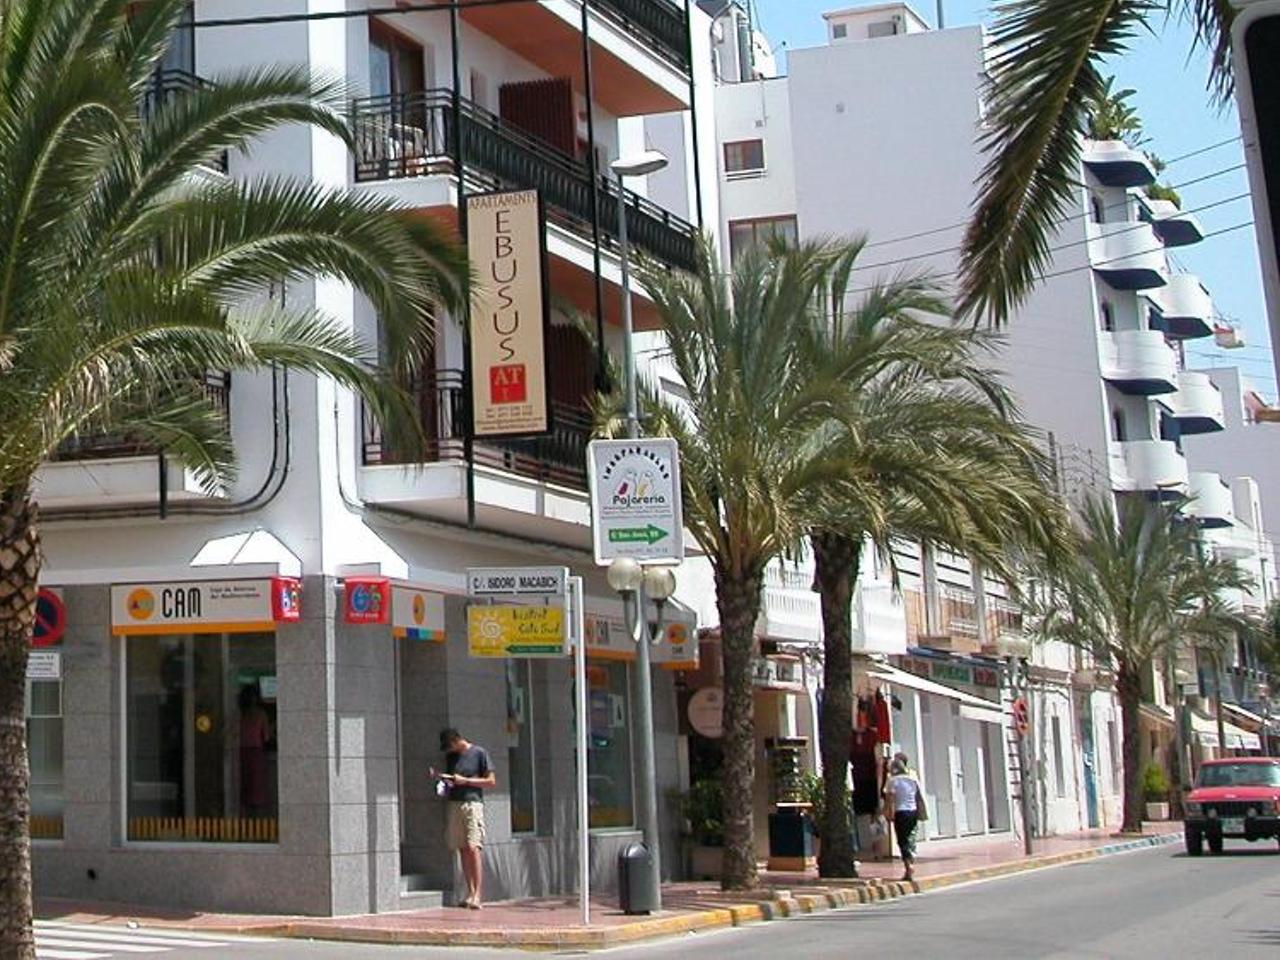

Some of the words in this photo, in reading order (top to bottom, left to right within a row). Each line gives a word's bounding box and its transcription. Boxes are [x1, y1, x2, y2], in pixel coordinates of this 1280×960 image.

[491, 210, 519, 361] EBUSUS
[494, 367, 523, 385] AT
[488, 577, 516, 589] ISIDORO
[162, 587, 201, 618] CAM
